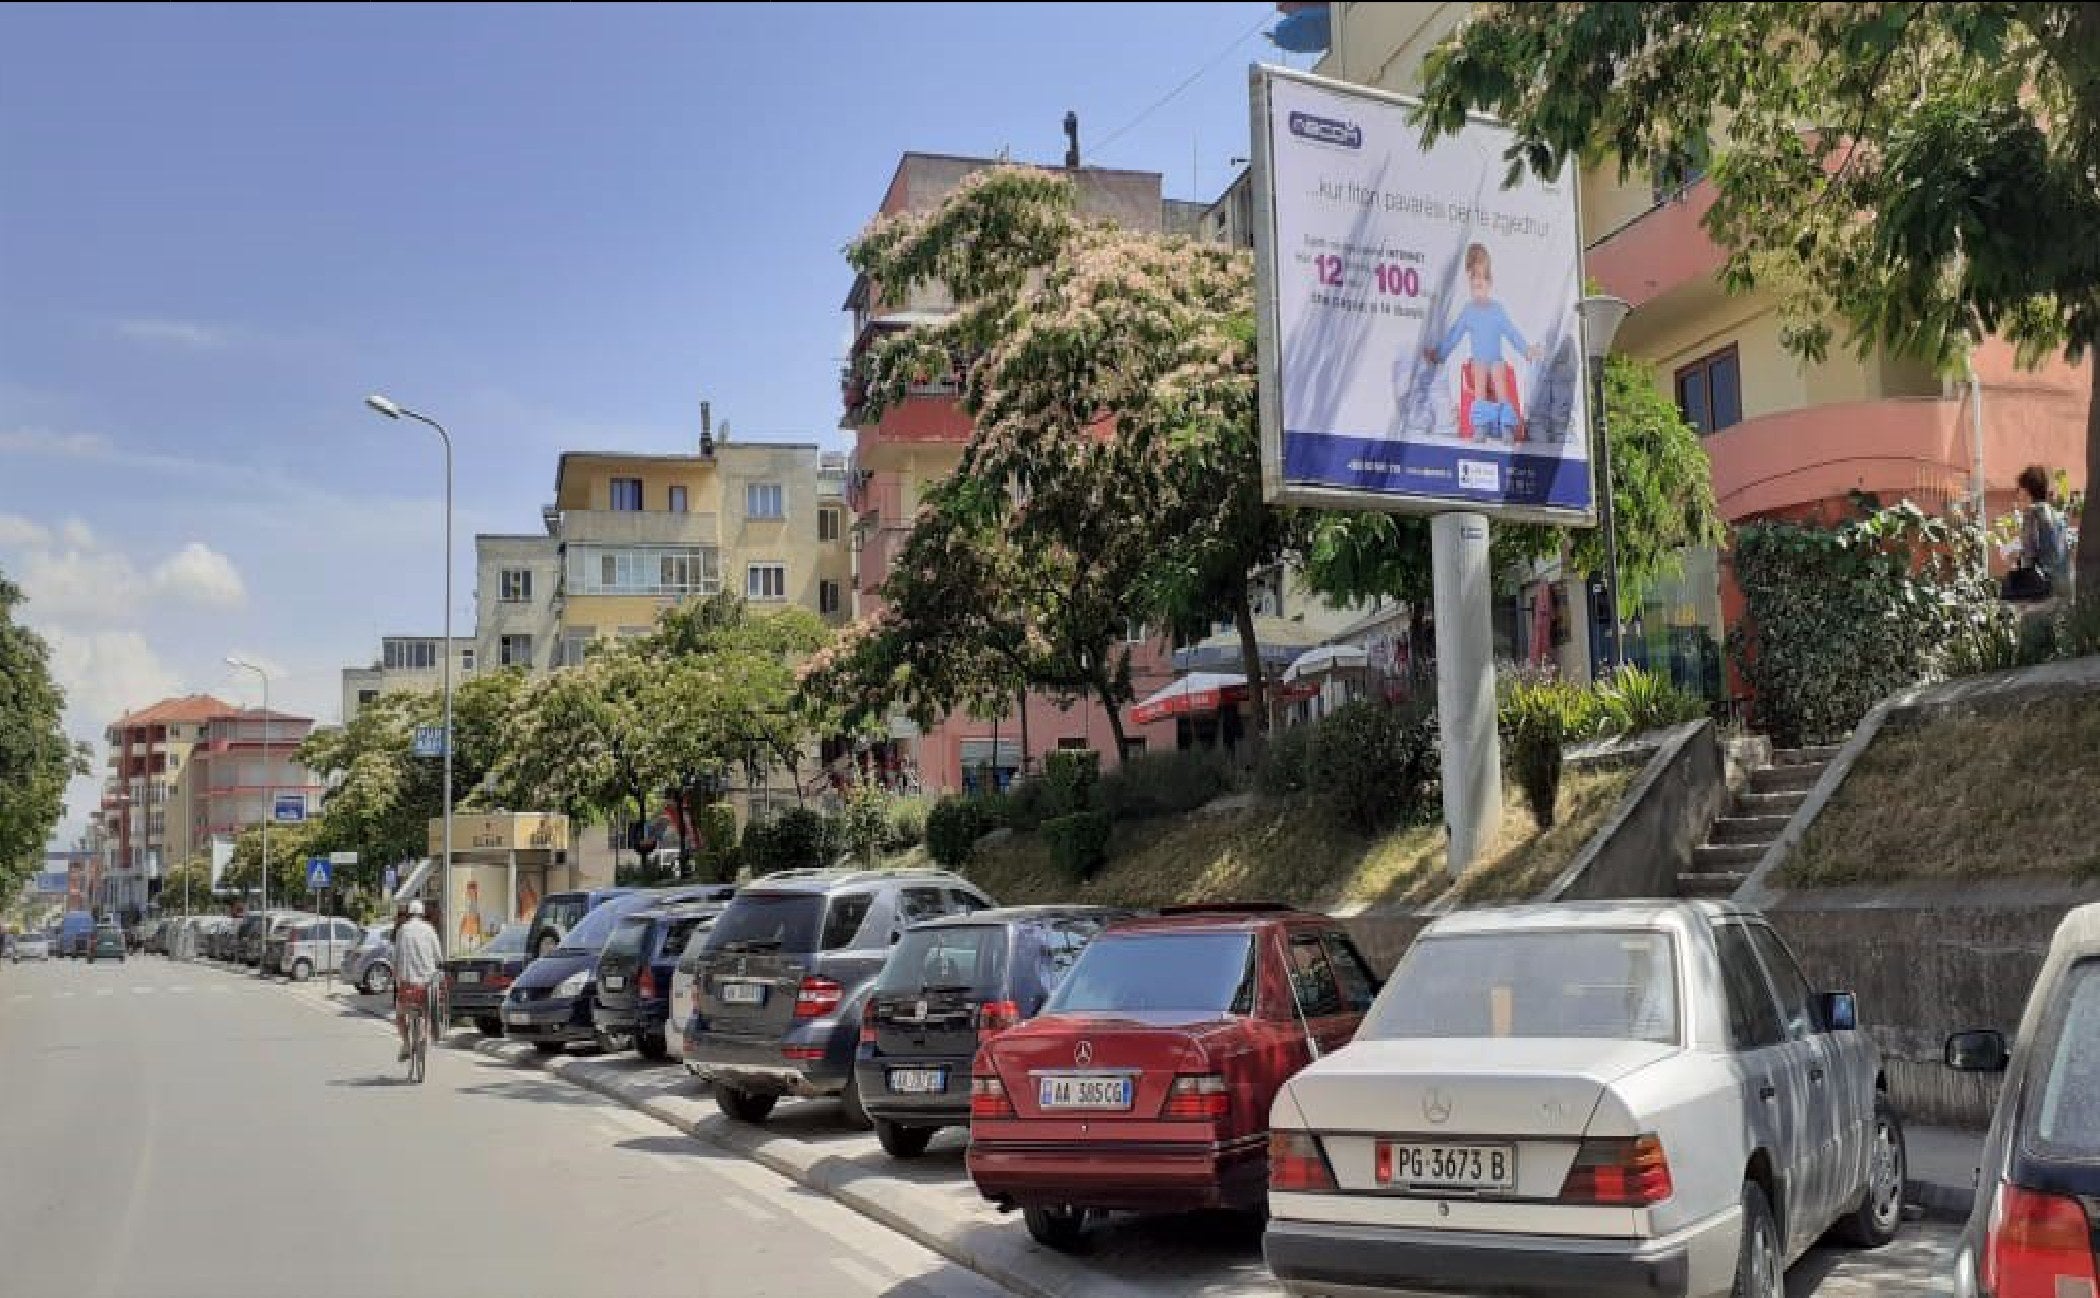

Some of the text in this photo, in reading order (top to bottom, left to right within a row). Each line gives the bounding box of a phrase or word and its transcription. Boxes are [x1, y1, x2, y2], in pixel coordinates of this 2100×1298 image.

[1313, 255, 1344, 288] 12
[1374, 262, 1419, 298] 100
[1055, 1082, 1071, 1103] AA
[1491, 1151, 1505, 1181] B
